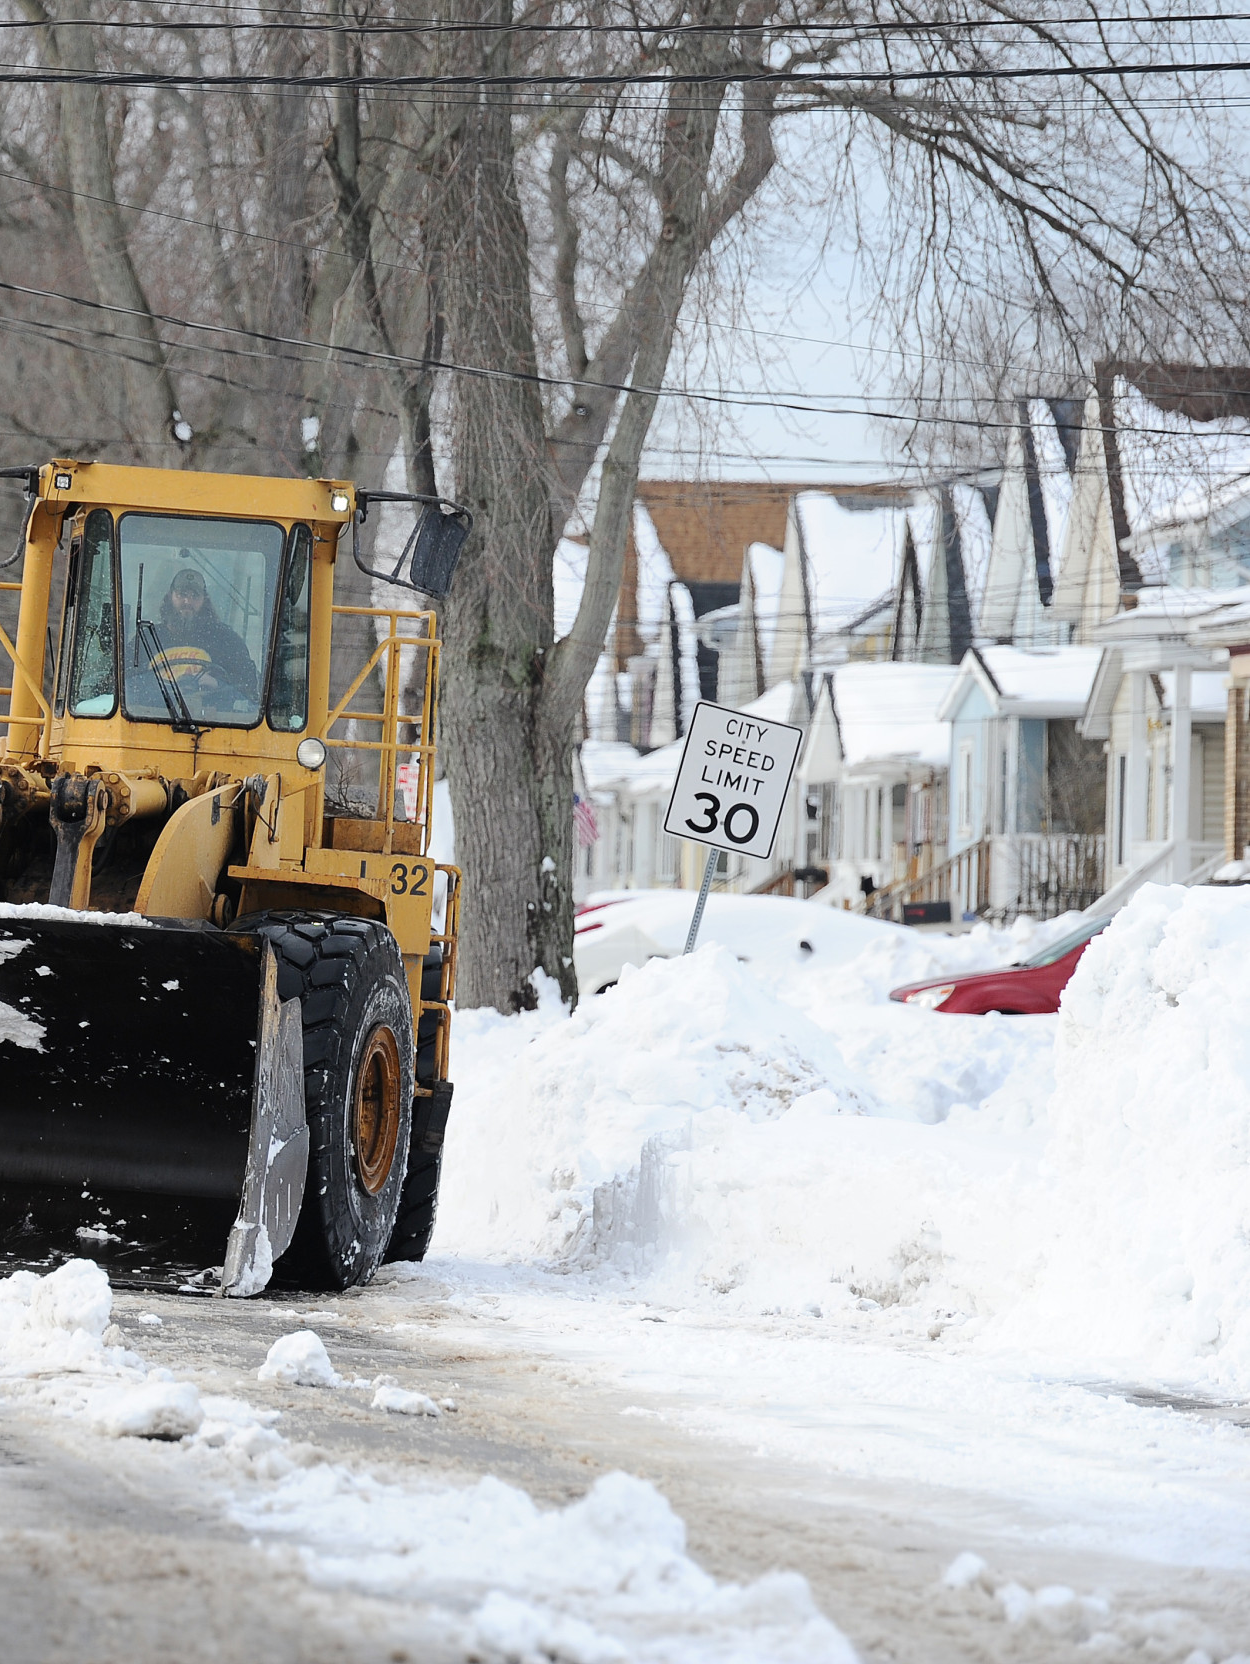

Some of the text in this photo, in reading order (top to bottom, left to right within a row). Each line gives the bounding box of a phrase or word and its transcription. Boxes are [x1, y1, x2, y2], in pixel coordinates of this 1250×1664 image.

[726, 719, 769, 743] CITY
[704, 740, 775, 772] SPEED
[701, 765, 765, 796] LIMIT
[684, 792, 760, 844] 30
[391, 863, 429, 896] 32
